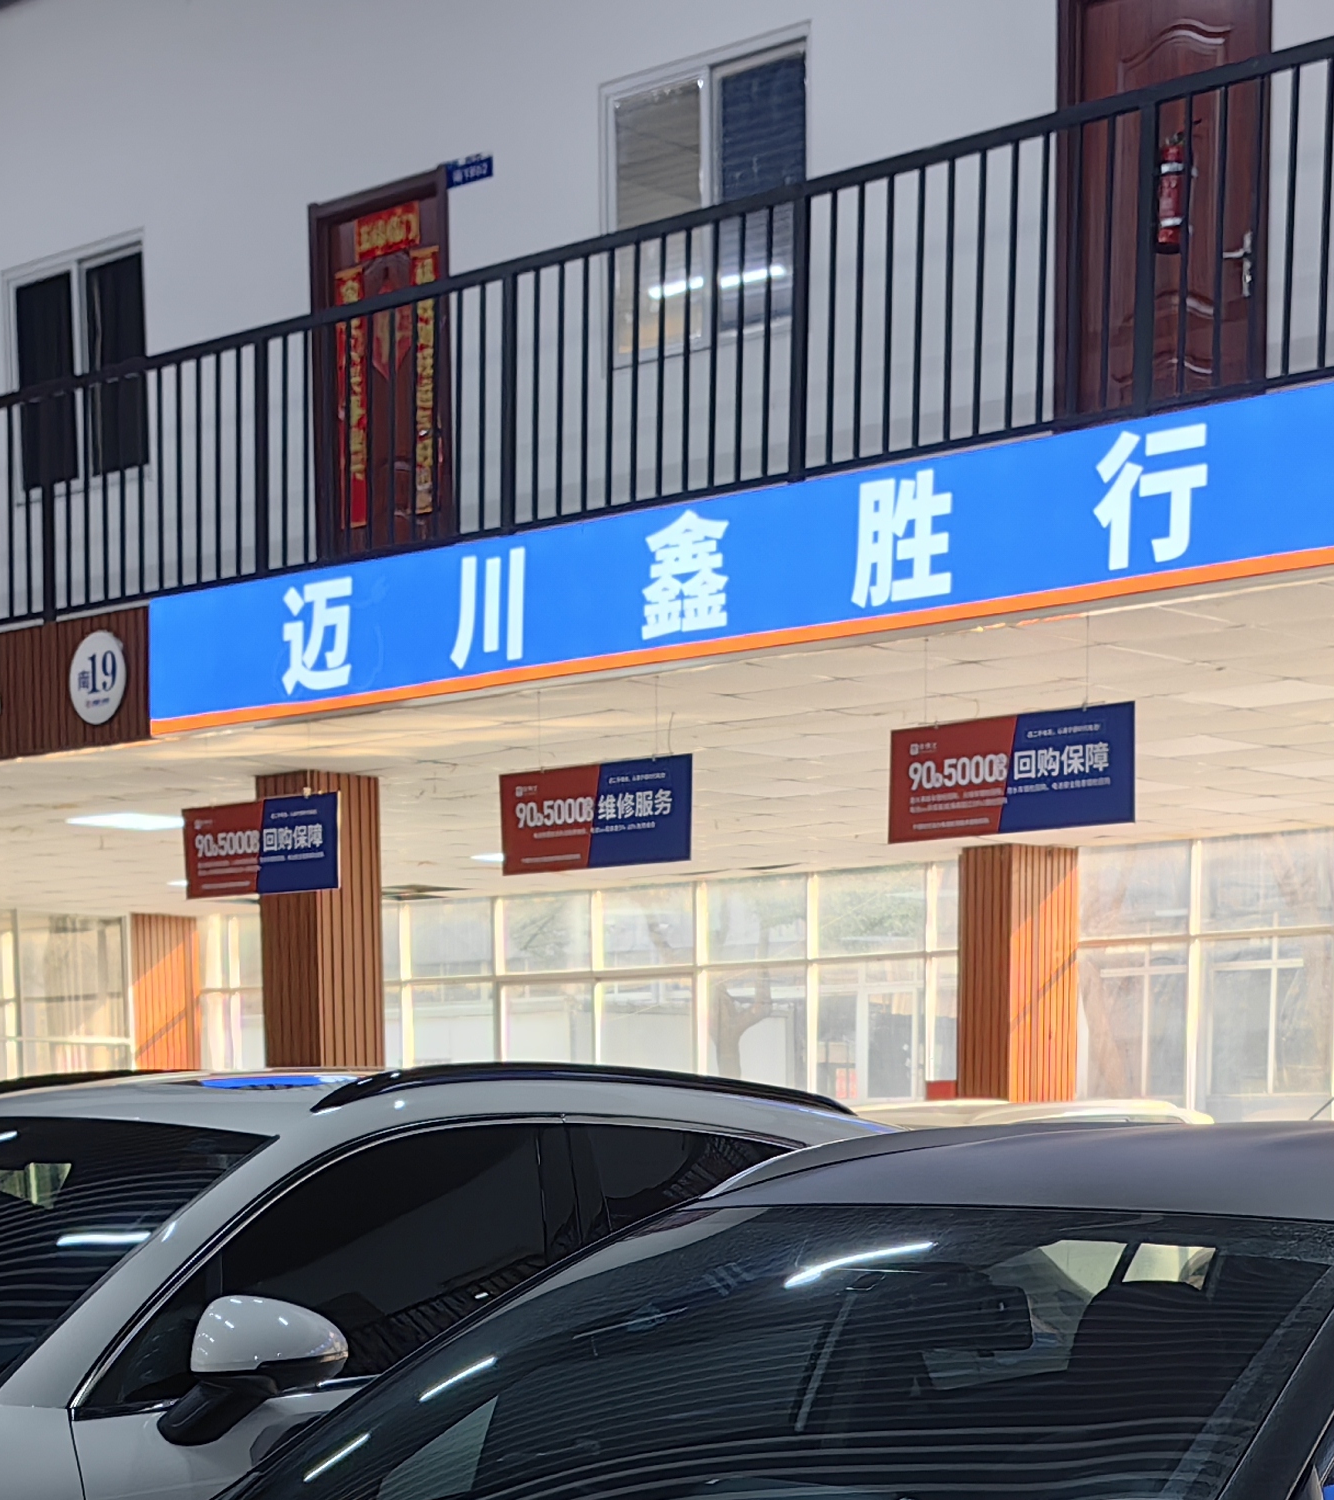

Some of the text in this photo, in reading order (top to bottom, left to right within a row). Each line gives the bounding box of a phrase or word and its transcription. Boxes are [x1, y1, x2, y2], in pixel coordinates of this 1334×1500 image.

[281, 422, 1209, 698] 迈川鑫胜行
[1013, 742, 1110, 780] 回购保障
[597, 789, 673, 822] 维修服务
[262, 823, 324, 853] 回购保障
